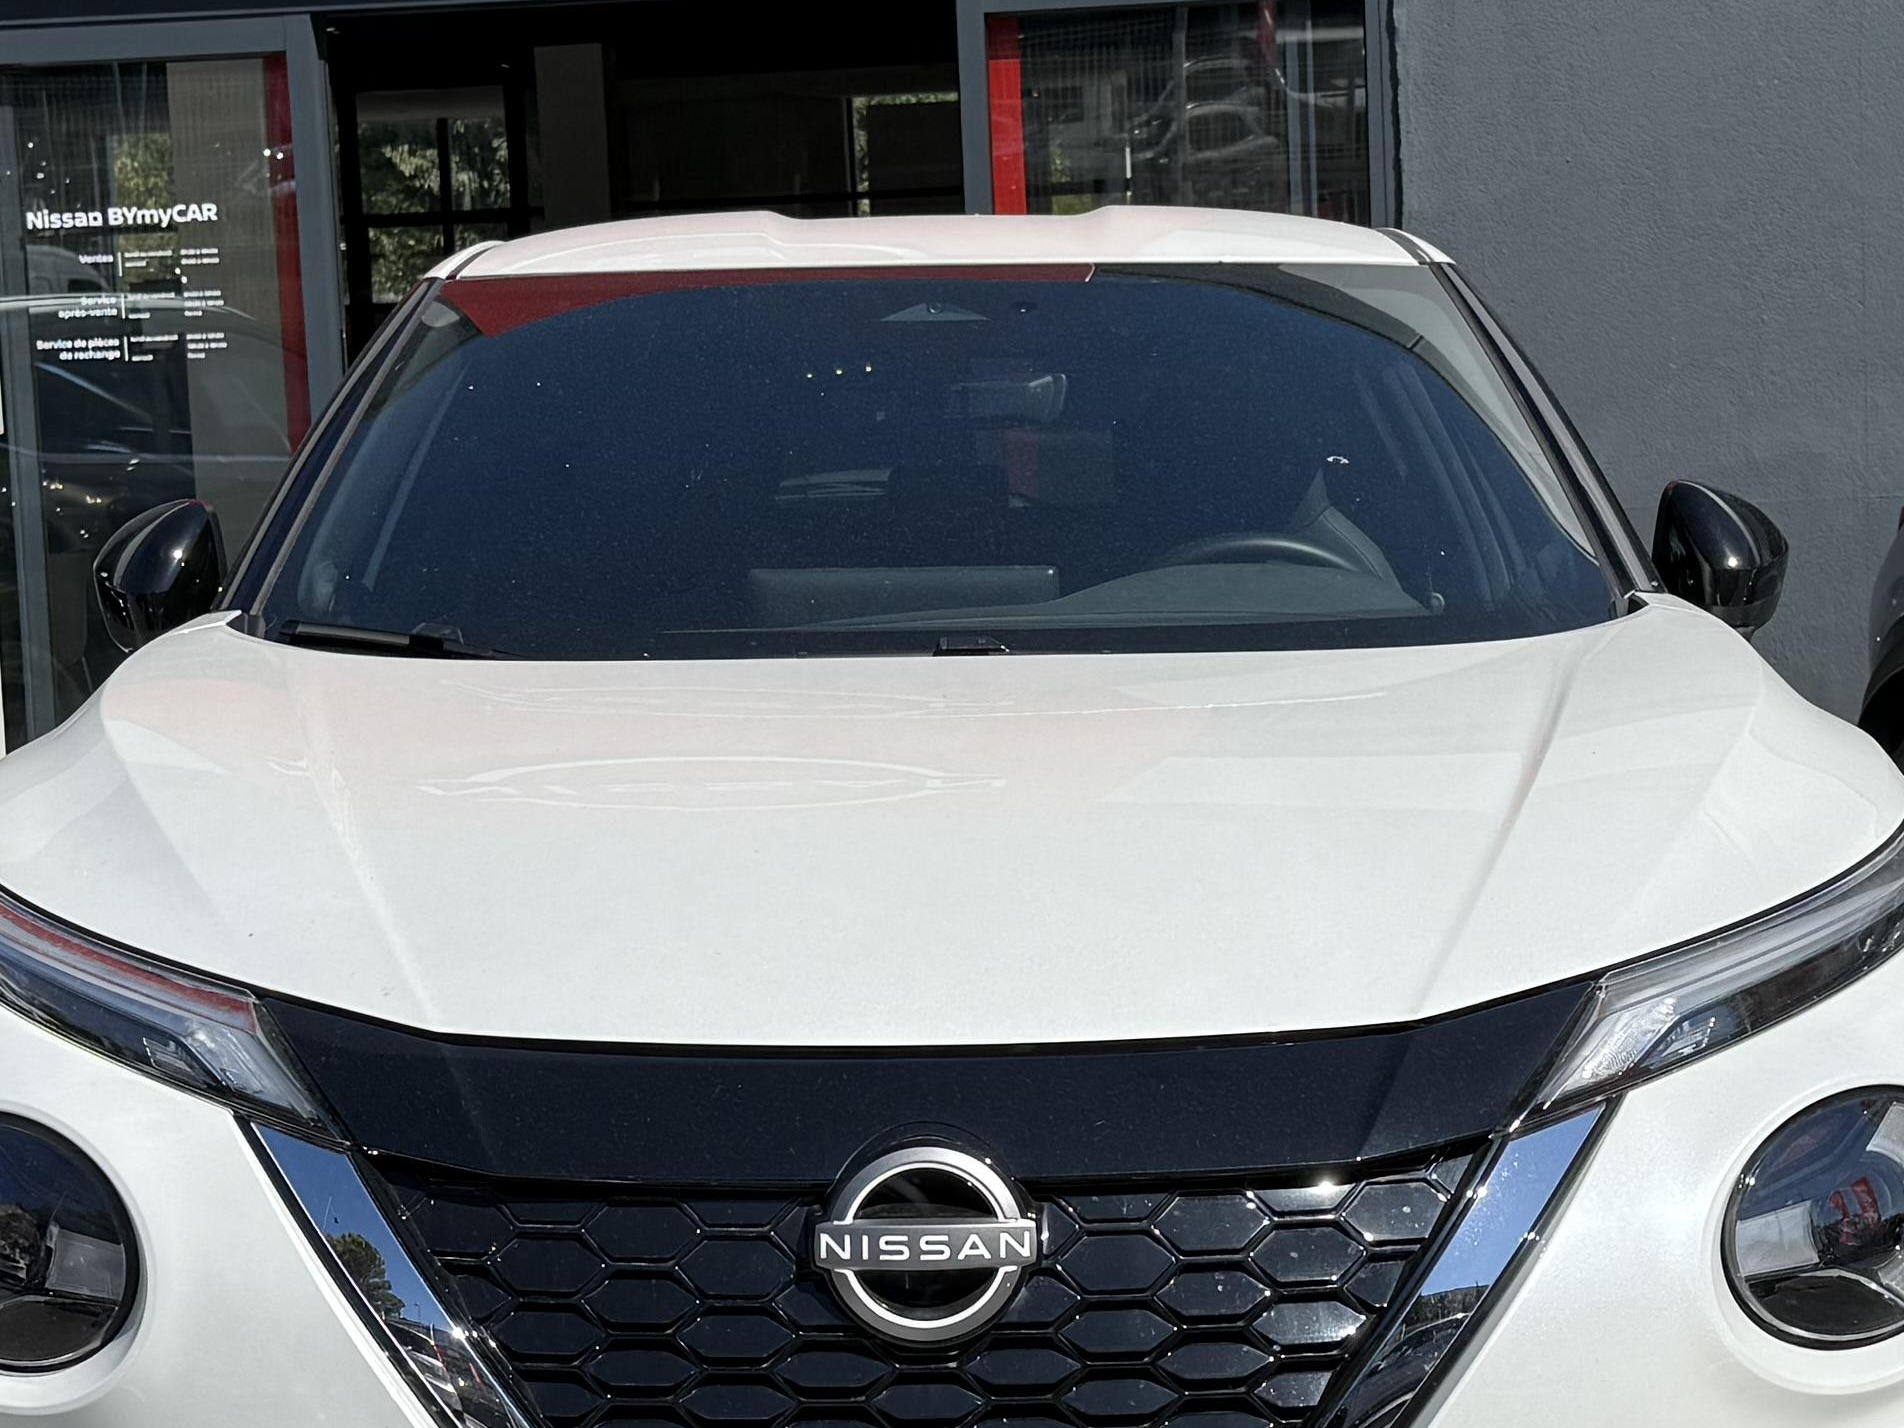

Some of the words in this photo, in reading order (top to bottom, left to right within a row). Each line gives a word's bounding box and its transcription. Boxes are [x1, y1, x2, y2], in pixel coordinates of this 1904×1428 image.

[26, 207, 103, 232] Nissan
[107, 202, 218, 229] BYmyCAR
[816, 1227, 1034, 1262] NISSAN
